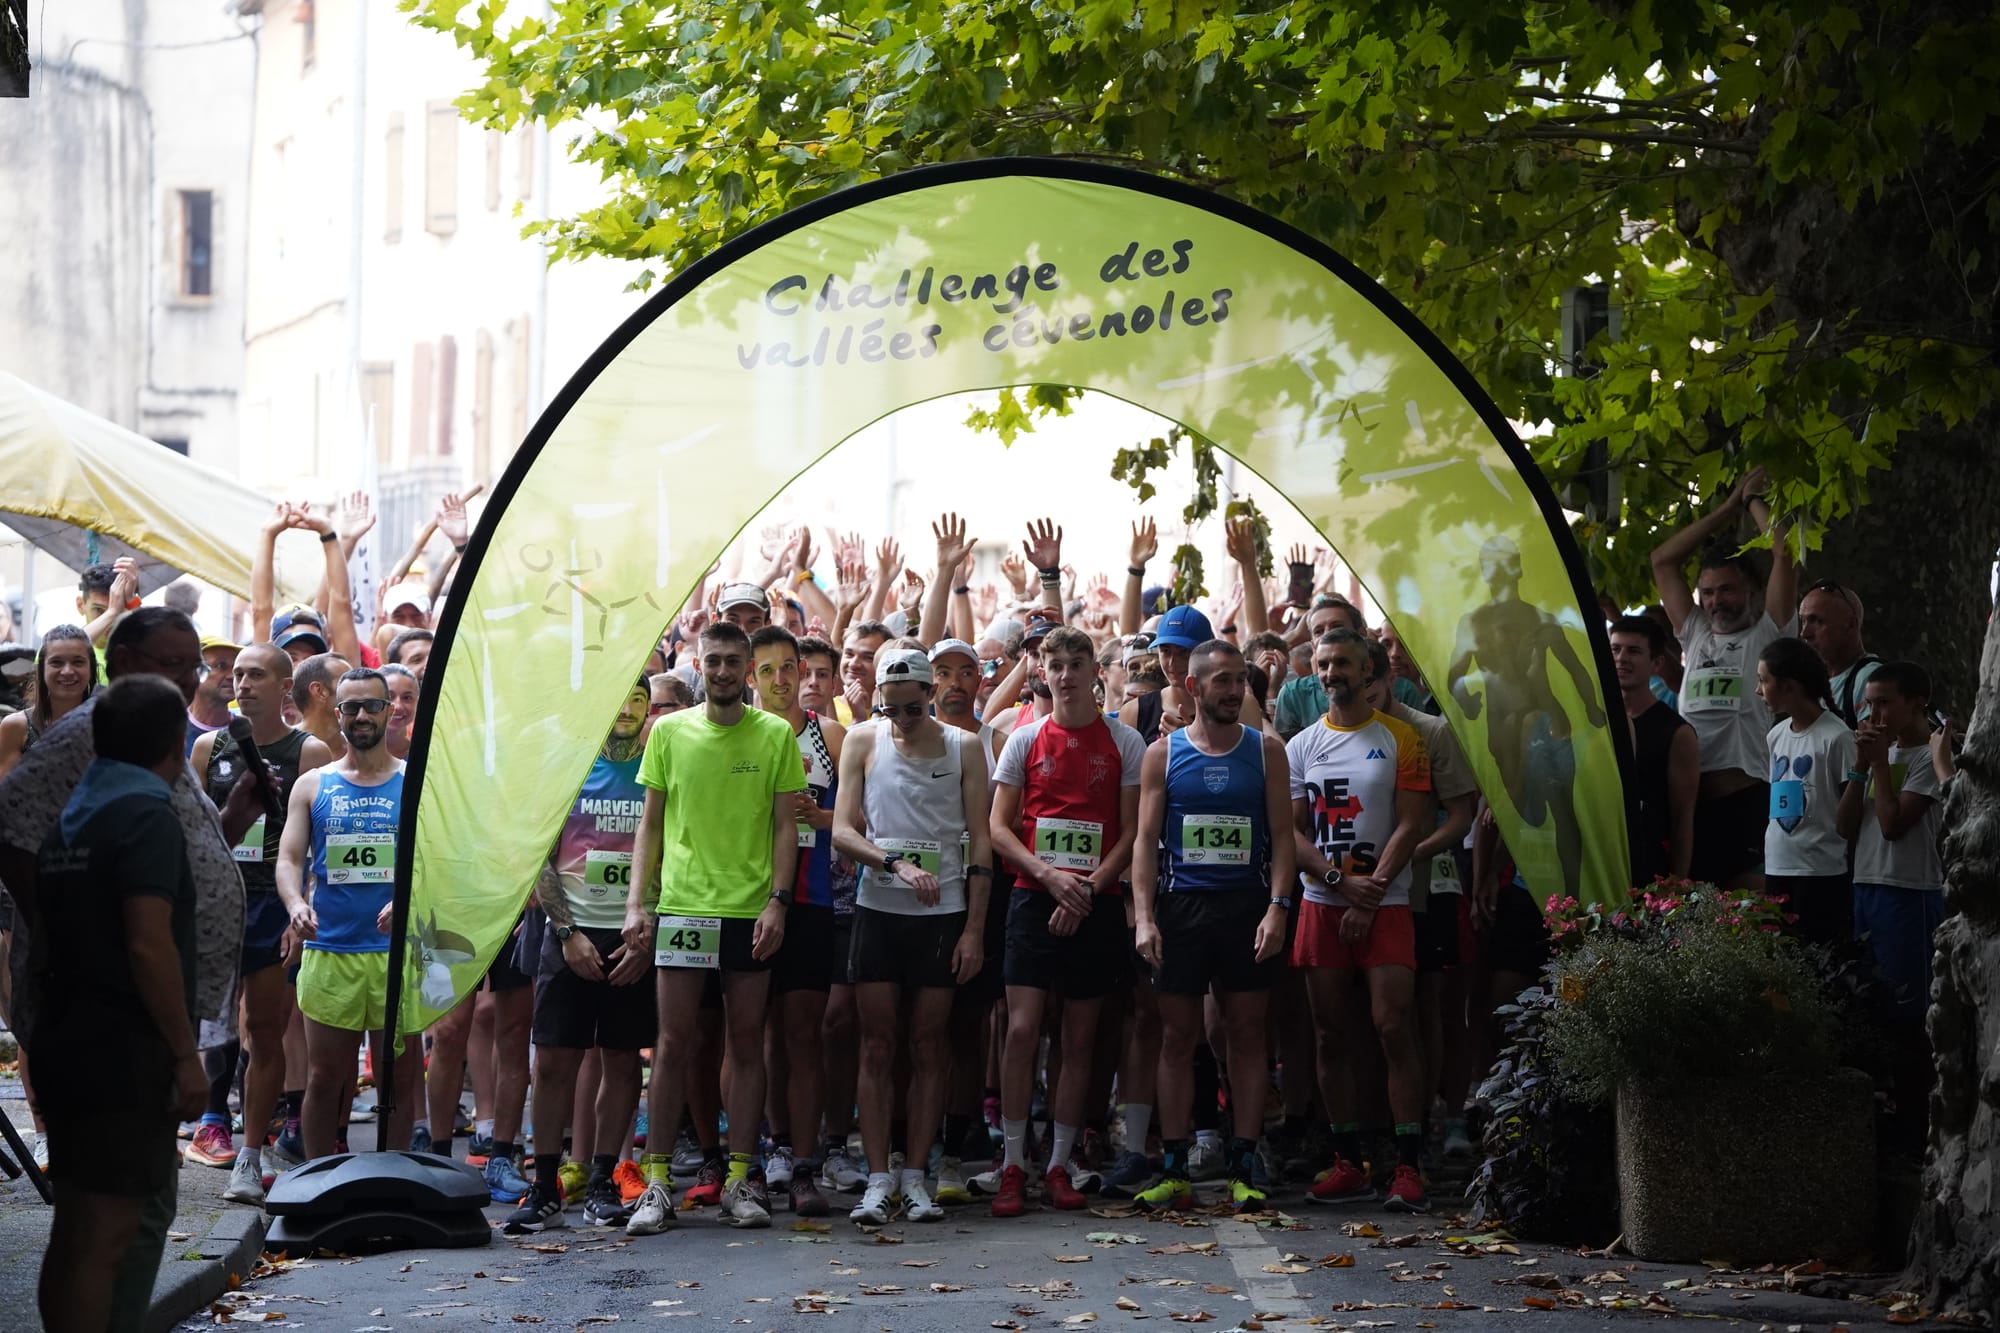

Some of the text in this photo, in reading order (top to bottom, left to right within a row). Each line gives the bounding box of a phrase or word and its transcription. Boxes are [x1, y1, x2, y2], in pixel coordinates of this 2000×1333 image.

[766, 239, 1194, 316] Challenge des
[737, 288, 1233, 370] vallées cévenoles
[1692, 678, 1733, 698] 117
[1779, 795, 1788, 809] 5
[1045, 831, 1092, 854] 113
[1192, 827, 1242, 849] 134
[342, 846, 377, 867] 46
[1319, 842, 1376, 873] TS
[669, 929, 701, 951] 43
